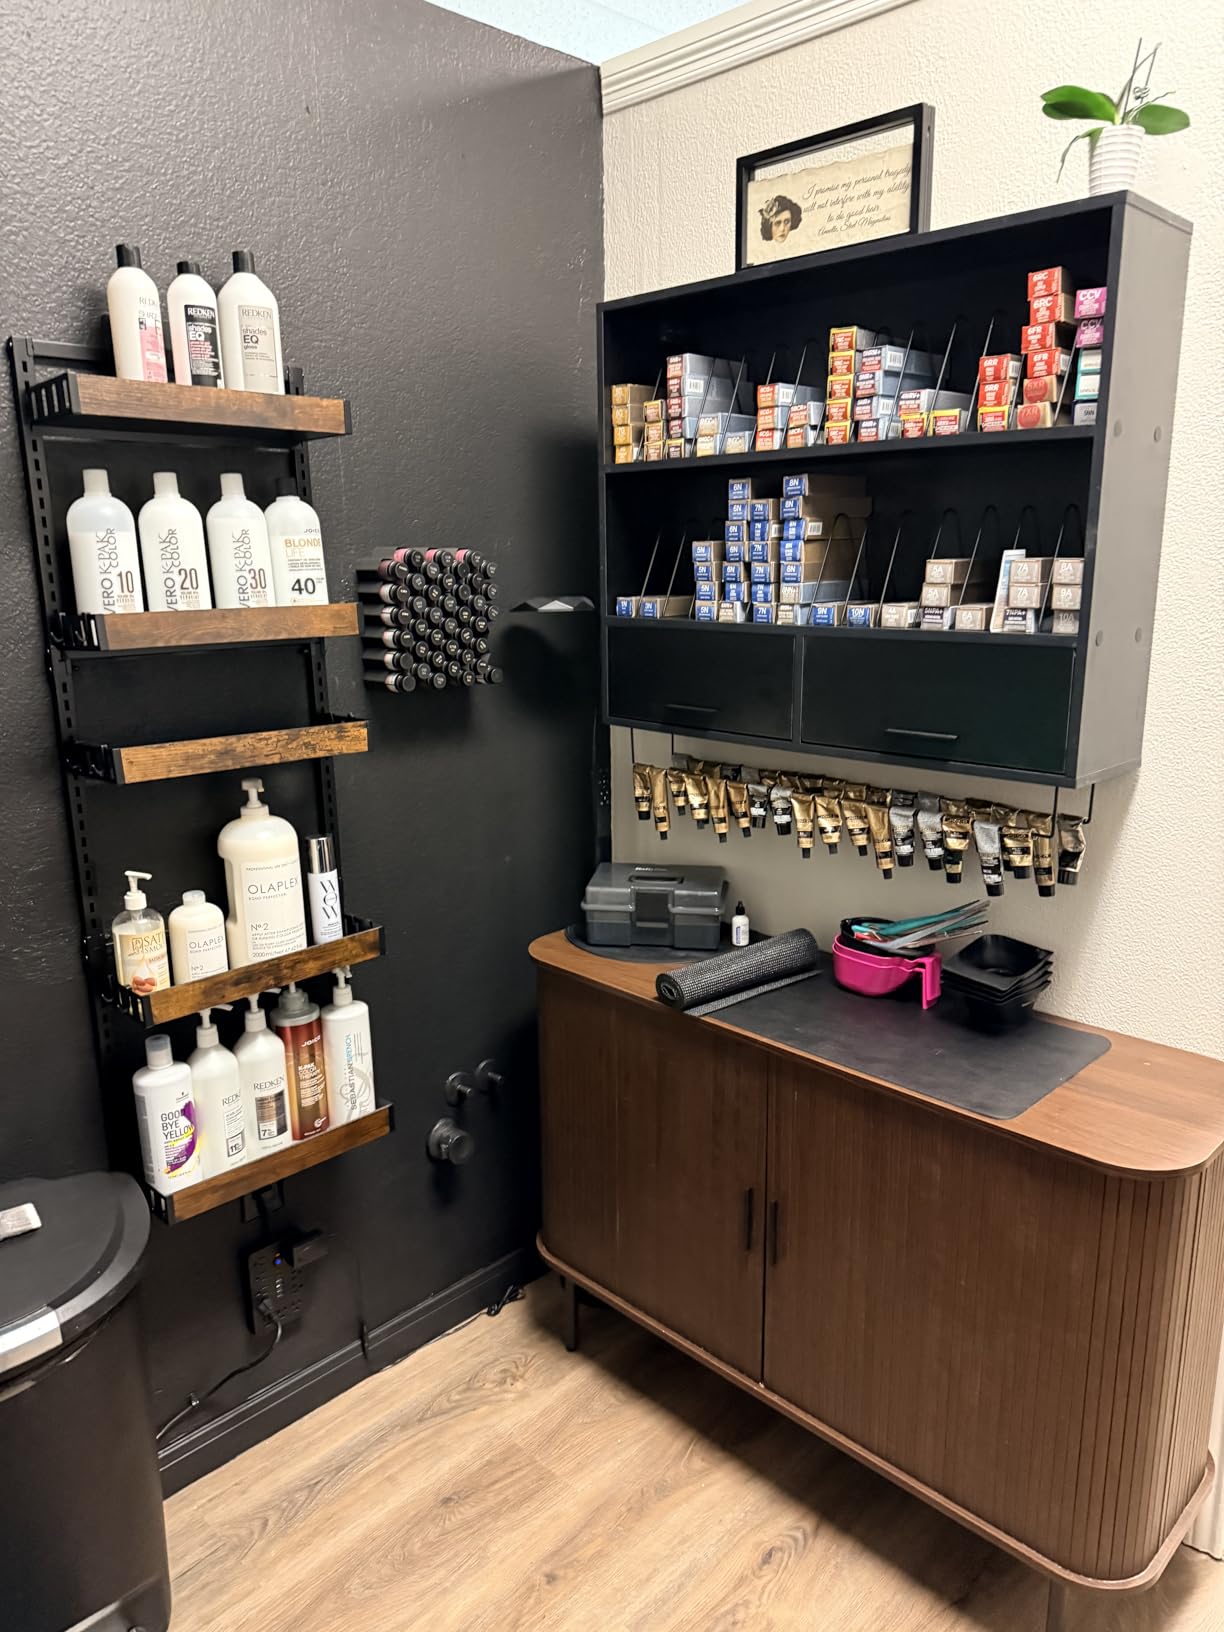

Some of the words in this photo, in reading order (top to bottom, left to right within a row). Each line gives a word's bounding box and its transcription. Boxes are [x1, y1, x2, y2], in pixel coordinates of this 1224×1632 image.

[841, 181, 852, 192] my
[852, 169, 884, 190] personal
[872, 188, 884, 200] my
[190, 331, 205, 341] EQ
[243, 334, 259, 345] EQ
[117, 570, 135, 594] 10
[178, 568, 199, 590] 20
[248, 568, 267, 590] 30
[291, 577, 316, 595] 40
[161, 1120, 181, 1132] BYE
[163, 1124, 194, 1140] YELLOW
